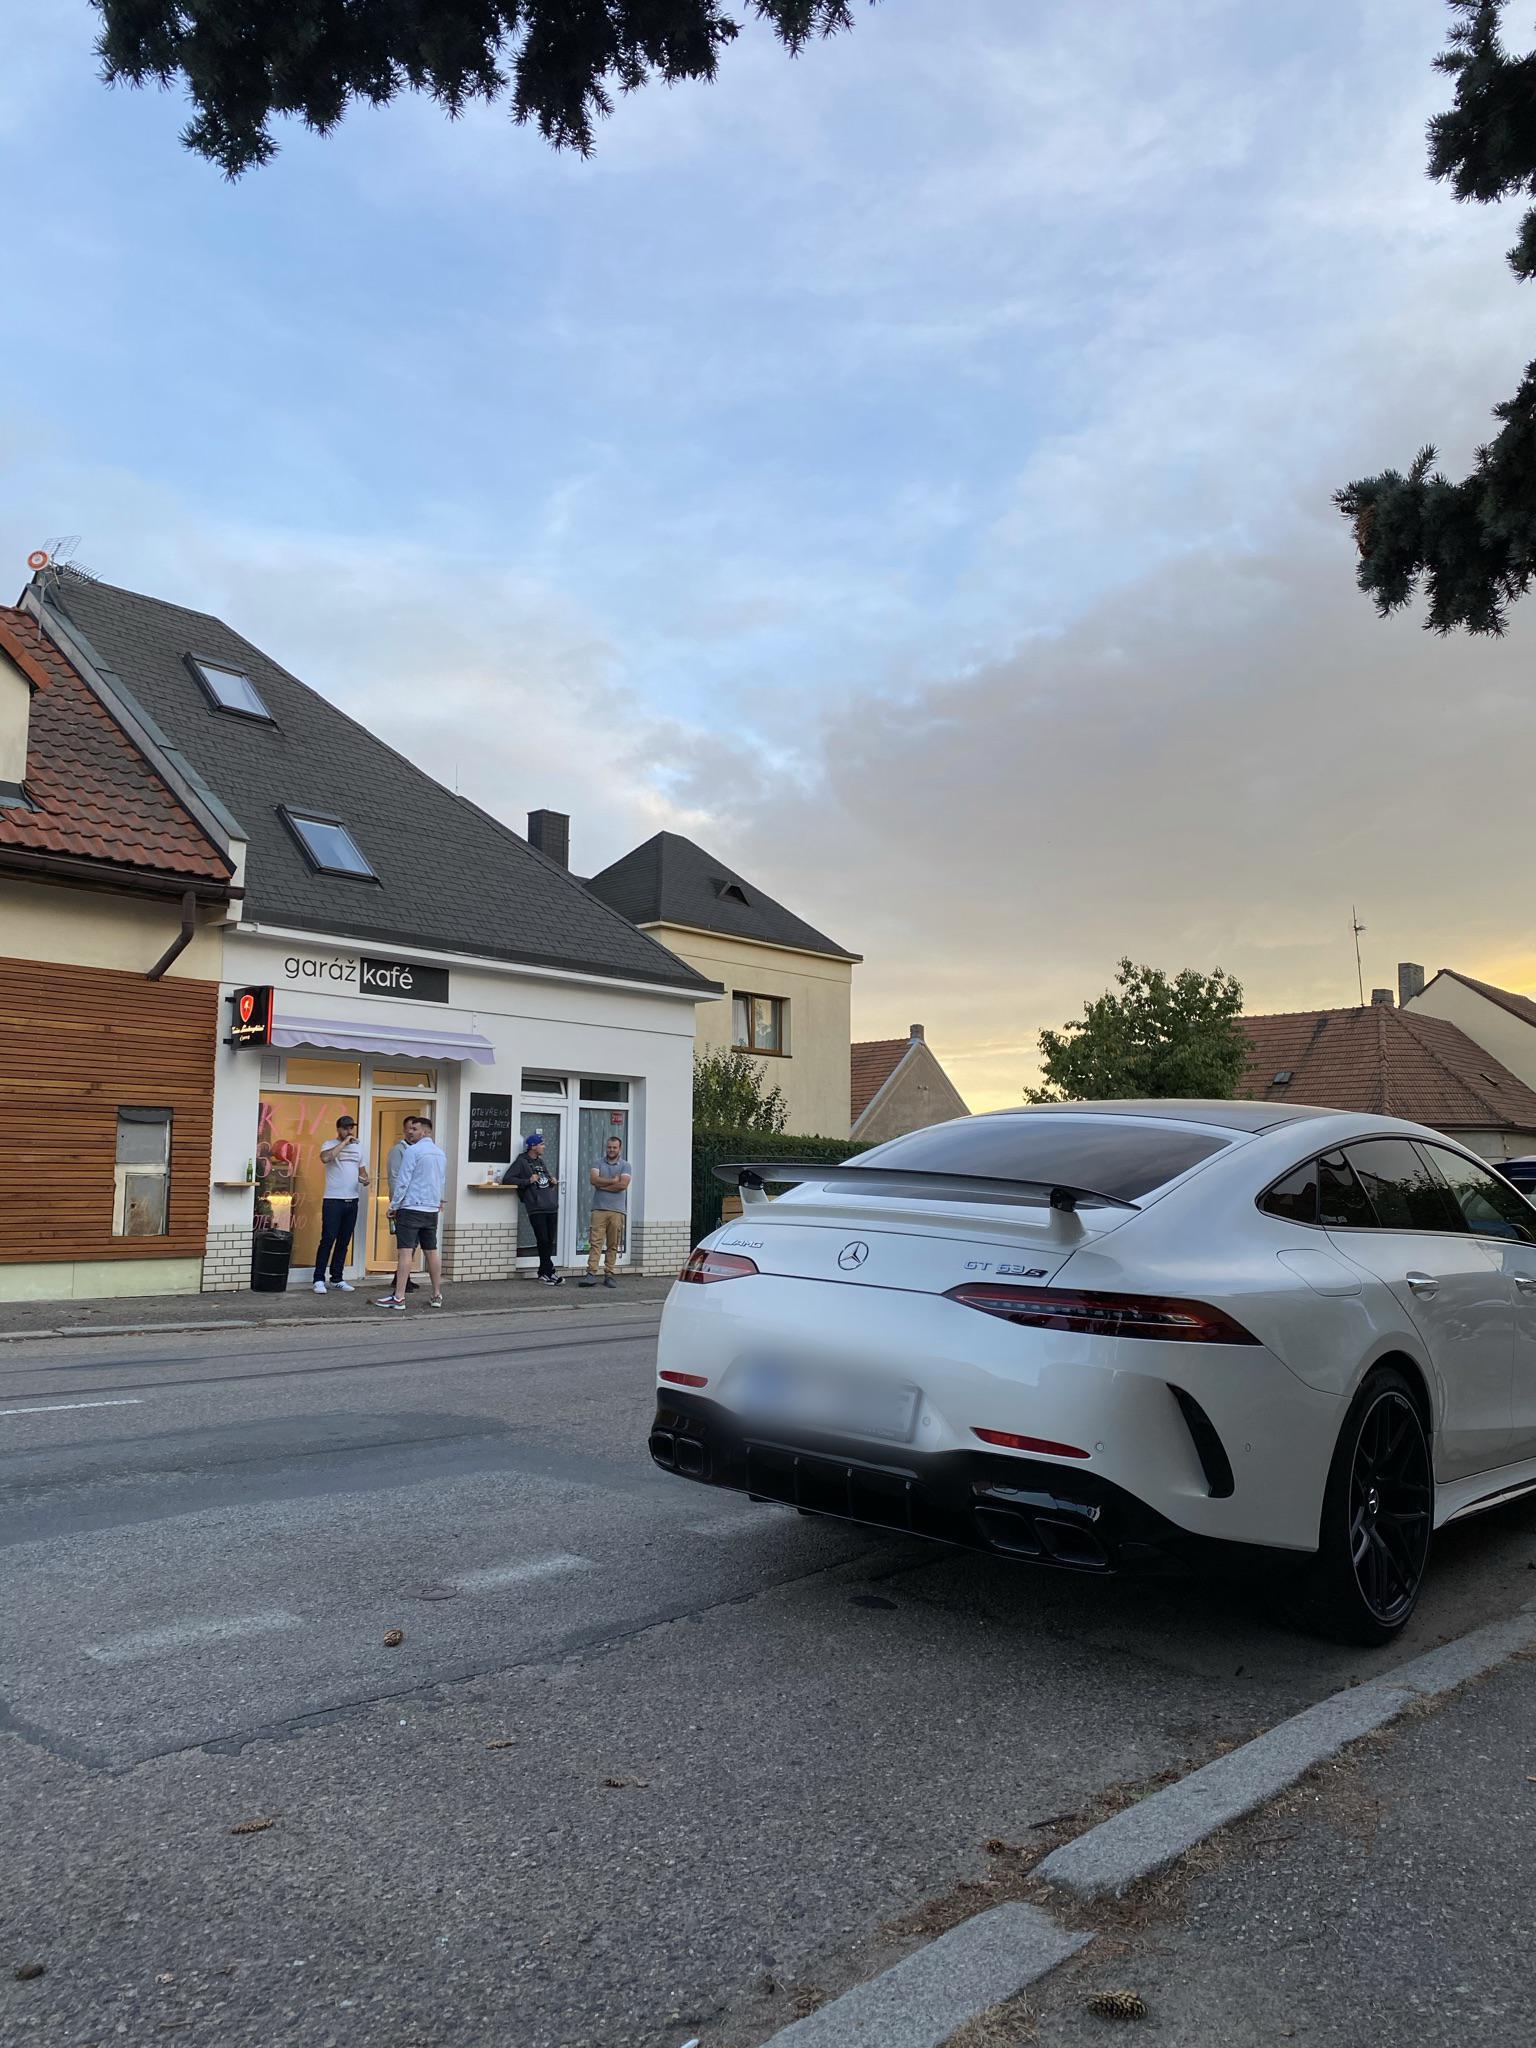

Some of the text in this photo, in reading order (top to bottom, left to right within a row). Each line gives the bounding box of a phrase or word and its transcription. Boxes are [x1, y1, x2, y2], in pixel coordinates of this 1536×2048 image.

[284, 956, 414, 989] garáž kafé
[963, 1261, 993, 1271] GT
